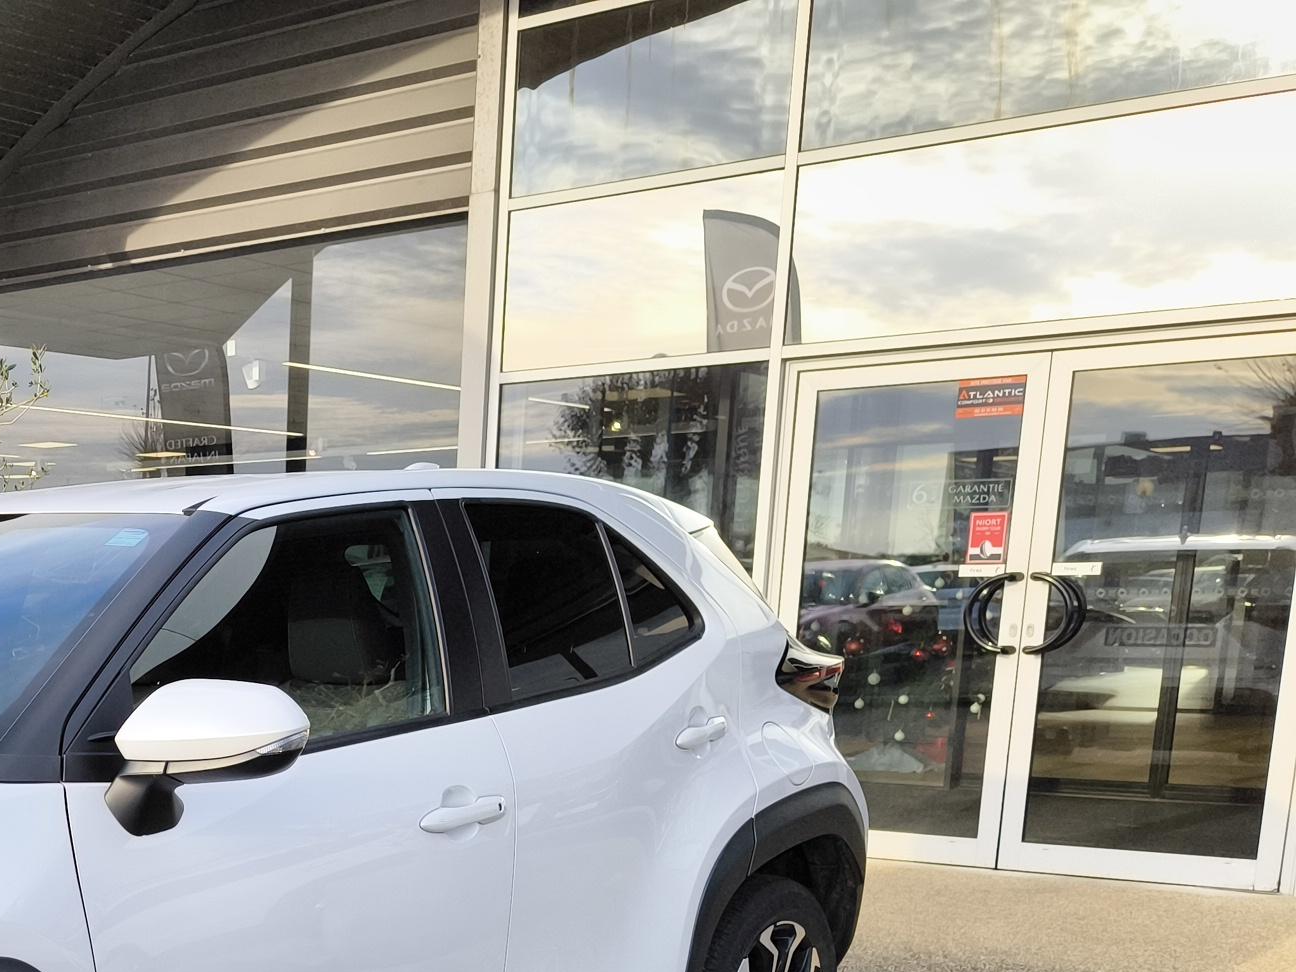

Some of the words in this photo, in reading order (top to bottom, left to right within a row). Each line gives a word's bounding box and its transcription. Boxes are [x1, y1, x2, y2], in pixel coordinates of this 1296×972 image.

[959, 387, 1024, 400] ATLANTIC
[948, 483, 1004, 494] GARANTIE
[954, 494, 997, 503] MAZDA
[976, 519, 1001, 527] NIORT
